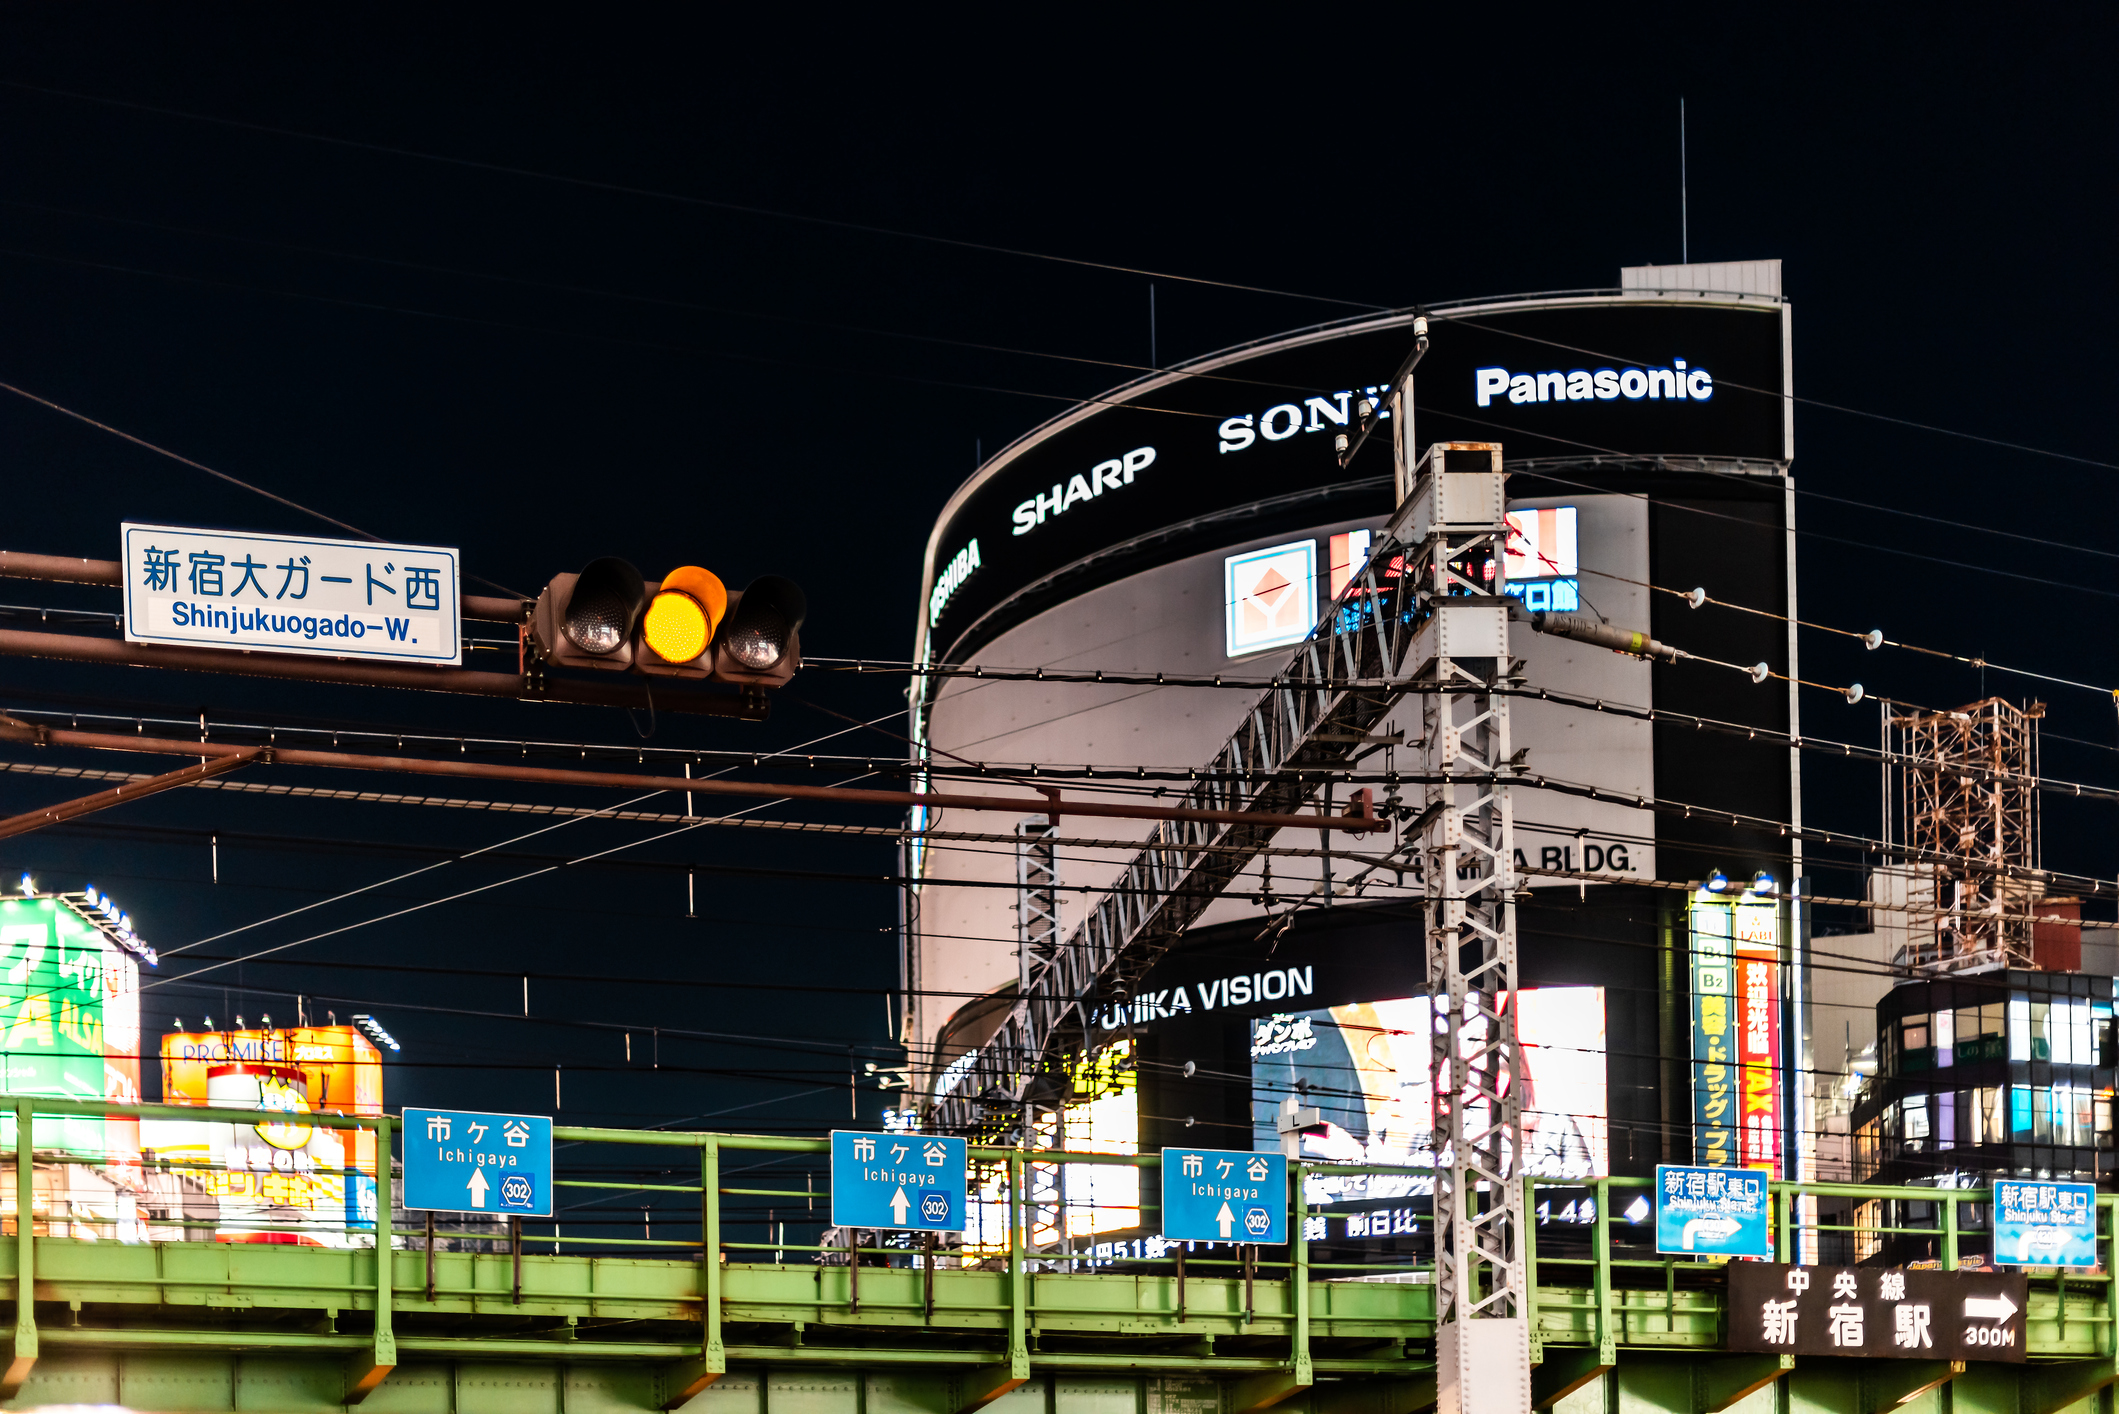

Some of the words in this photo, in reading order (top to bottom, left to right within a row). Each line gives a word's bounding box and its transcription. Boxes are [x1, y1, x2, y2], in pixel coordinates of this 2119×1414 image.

[1476, 358, 1713, 407] Panasonic
[1012, 446, 1157, 536] SHARP
[143, 545, 441, 611] 新宿大ガード西
[171, 601, 418, 643] Shinjukuogado-W.
[1540, 843, 1637, 874] BLDG.
[1740, 930, 1772, 941] LABI
[1196, 965, 1314, 1011] VISION
[1703, 973, 1723, 988] B2
[183, 1040, 284, 1065] PROMISE
[1746, 1056, 1773, 1114] TAX
[438, 1146, 517, 1169] Ichigaya
[864, 1167, 936, 1188] Ichigaya
[1664, 1170, 1760, 1197] 新宿駅東口
[506, 1183, 528, 1200] 302
[1191, 1182, 1259, 1201] Ichigaya
[2000, 1184, 2088, 1210] 新宿駅東口
[925, 1200, 945, 1216] 302
[2004, 1208, 2048, 1225] Shinjuku
[1248, 1214, 1267, 1229] 302
[1346, 1207, 1419, 1239] 前日比
[1788, 1268, 1906, 1301] 中央線
[1762, 1299, 1933, 1349] 新宿駅
[1965, 1326, 2016, 1347] 300M
